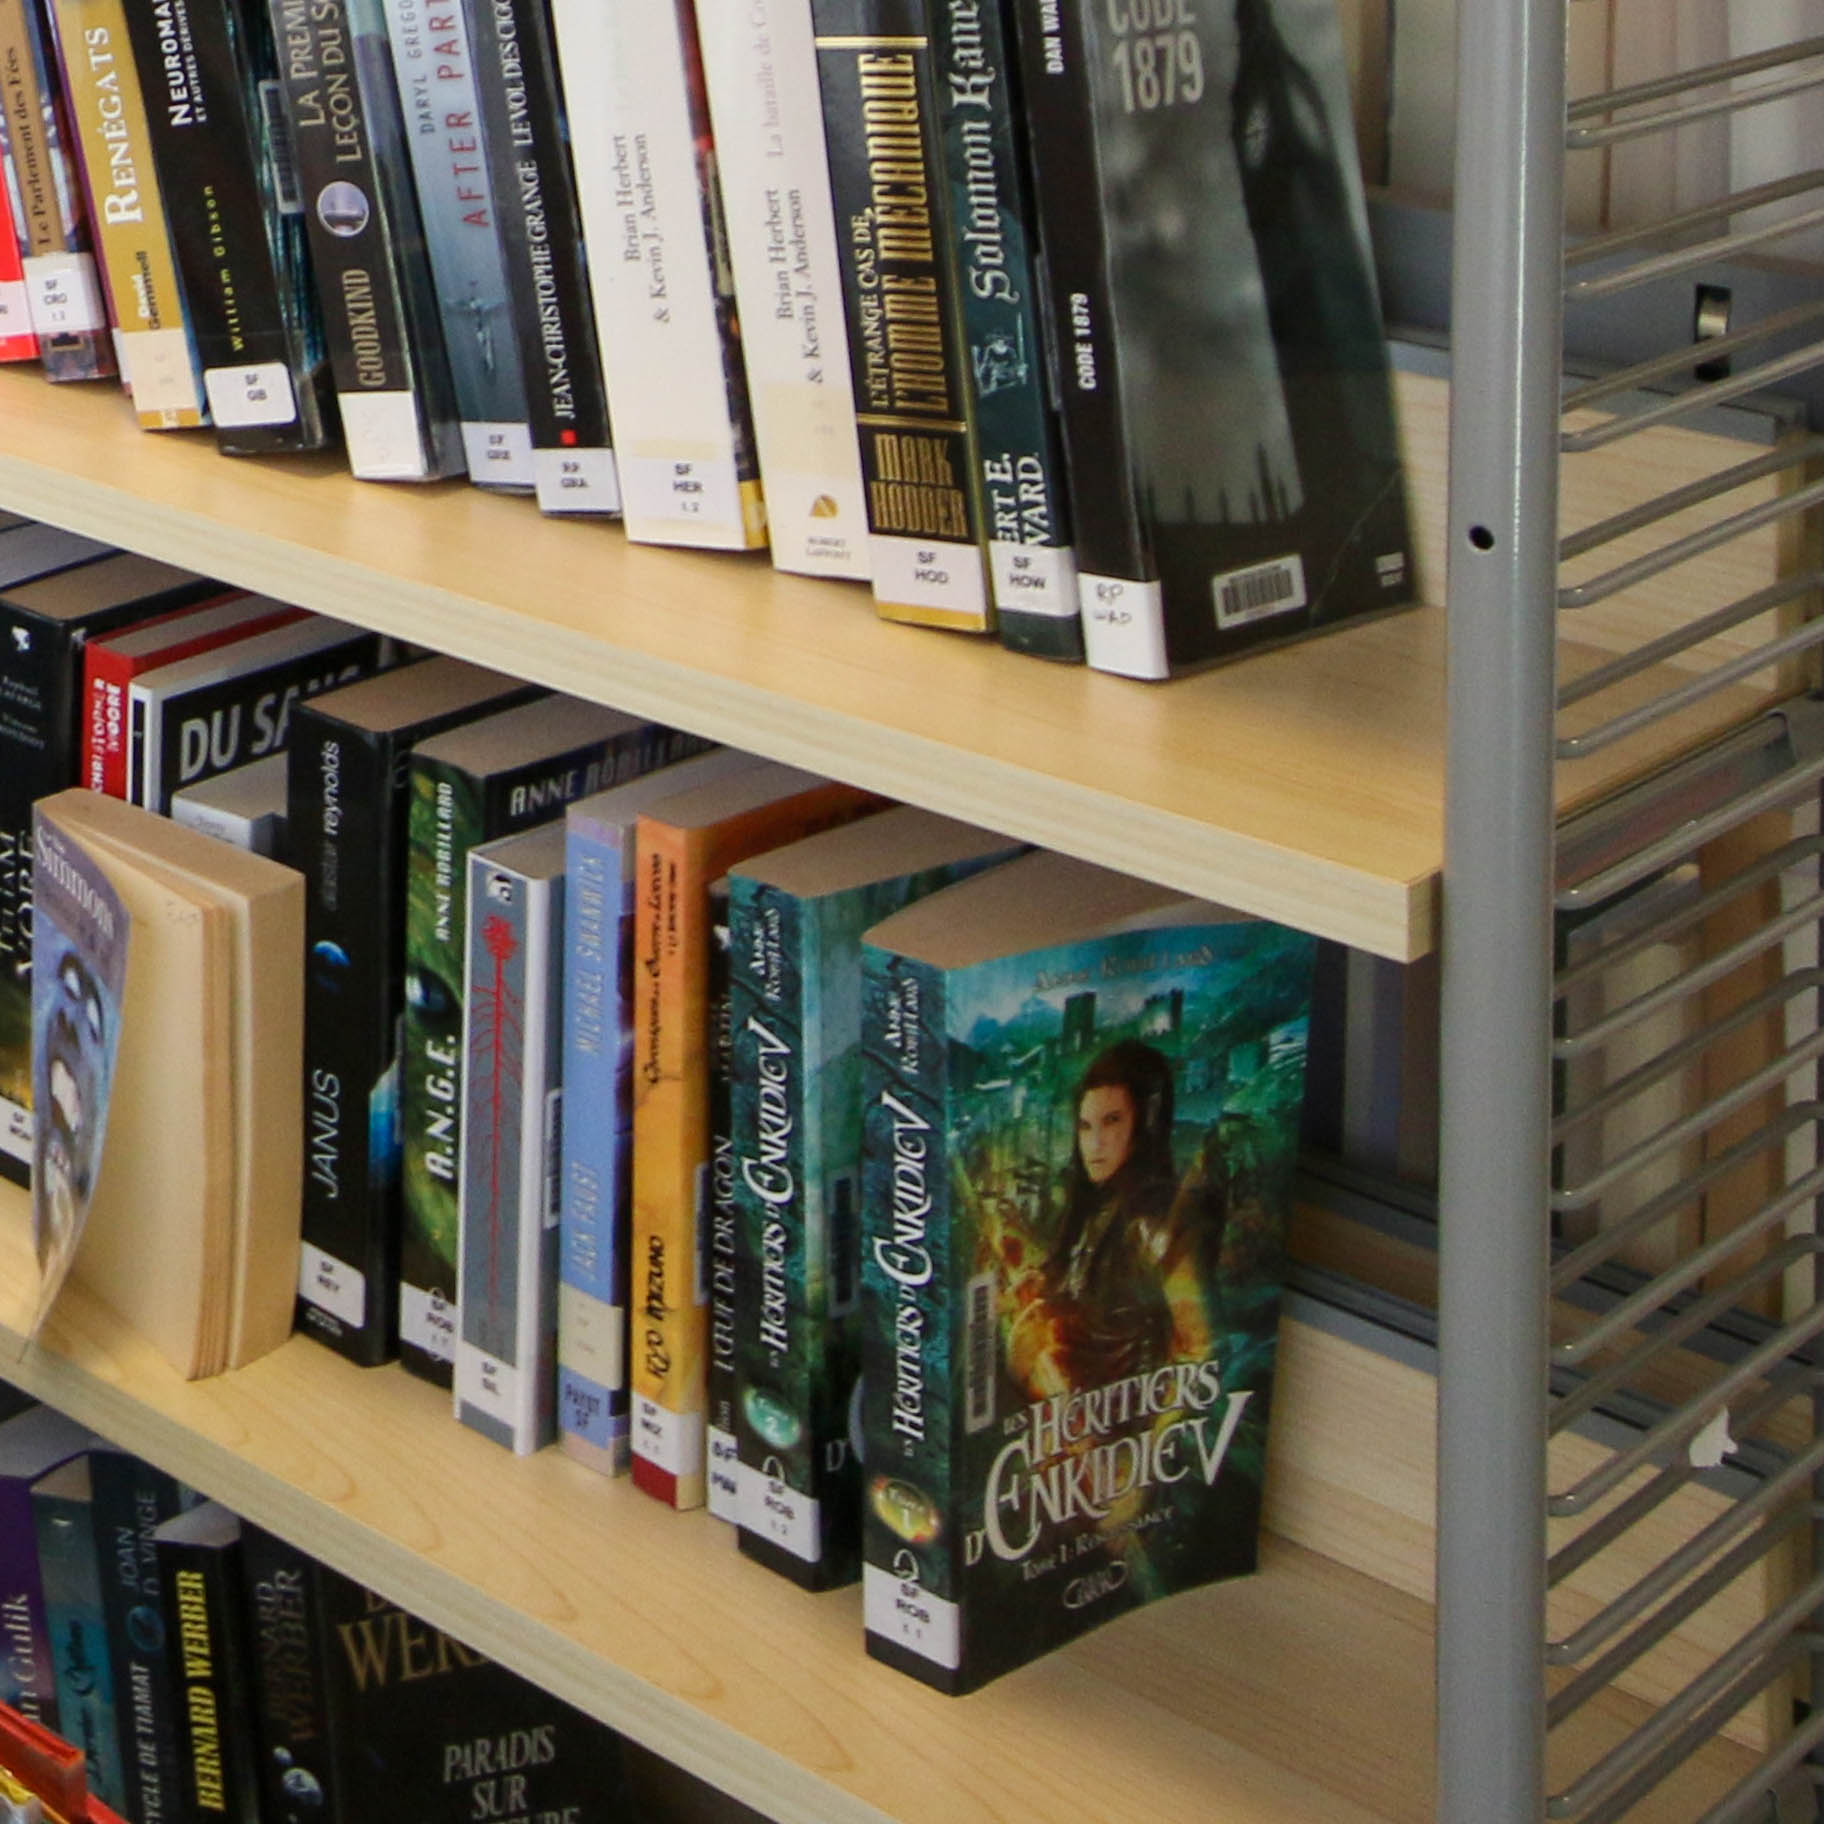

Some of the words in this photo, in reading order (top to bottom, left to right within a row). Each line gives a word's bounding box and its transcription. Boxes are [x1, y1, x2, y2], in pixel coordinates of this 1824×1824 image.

[3, 47, 22, 86] Fées
[323, 29, 343, 65] DU
[1046, 42, 1065, 74] DAN
[1112, 36, 1205, 113] 1879
[6, 86, 28, 118] des
[180, 56, 206, 106] AUTRES
[298, 82, 323, 127] LA
[414, 75, 436, 135] DARYL
[92, 28, 141, 227] RENÉGATS
[333, 73, 363, 165] LEÇON
[18, 125, 46, 220] Parlement
[443, 109, 491, 229] AFTER
[612, 135, 634, 207] Herbert
[634, 134, 656, 219] Anderson
[859, 51, 933, 265] MECANIQUE
[204, 185, 227, 259] Gibson
[518, 157, 549, 240] GRANGE
[765, 190, 787, 263] Herbert
[963, 124, 1020, 304] Solomon
[619, 216, 641, 265] Brian
[783, 186, 813, 290] Anderson
[859, 238, 877, 281] CAS
[650, 252, 667, 299] Kevin
[769, 273, 798, 319] Brian
[219, 267, 245, 352] William
[347, 268, 385, 387] GOODKIND
[532, 242, 575, 420] JEAN-CHRISTOPHE
[800, 313, 823, 362] Kevin
[1071, 292, 1090, 343] 1879
[863, 284, 891, 409] L'ÉTRANGE
[883, 273, 950, 411] L'HOMME
[1078, 347, 1096, 391] CODE
[673, 480, 703, 494] HER
[876, 435, 951, 487] MARK
[989, 453, 1011, 488] E.
[872, 476, 968, 535] HODDER
[914, 569, 950, 585] HOD
[1009, 573, 1046, 591] HOW
[1012, 556, 1032, 569] SF
[1096, 582, 1124, 603] RP
[180, 717, 243, 781] DU
[321, 740, 340, 837] reynolds
[509, 774, 580, 817] ANNE
[437, 779, 453, 884] ROBILLARD
[435, 888, 451, 943] ANNE
[584, 853, 606, 965] SWANWICK
[581, 969, 602, 1053] MICHAEL
[885, 1007, 901, 1051] ANNE
[307, 1069, 341, 1199] JANUS
[422, 1034, 457, 1180] A.N.G.E.
[574, 1162, 599, 1219] FAUST
[716, 1136, 734, 1276] DRAGON
[570, 1221, 594, 1281] JACK
[647, 1235, 665, 1319] MIZUNO
[315, 1279, 340, 1295] REY
[716, 1280, 733, 1300] DE
[426, 1315, 454, 1330] ROB
[640, 1421, 664, 1438] MIZ
[1004, 1405, 1028, 1434] LES
[1030, 1361, 1220, 1466] HÉRITIERS
[763, 1497, 794, 1519] ROB
[964, 1392, 1249, 1567] D'ENKIDIEV
[176, 1568, 214, 1677] WERBER
[894, 1600, 930, 1623] ROB
[899, 1585, 919, 1601] SF
[2, 1594, 34, 1668] Gulik
[129, 1662, 152, 1738] TIAMAT
[136, 1744, 154, 1767] DE
[184, 1682, 225, 1812] BERNARD
[441, 1725, 556, 1784] PARADIS
[471, 1775, 528, 1818] SUR
